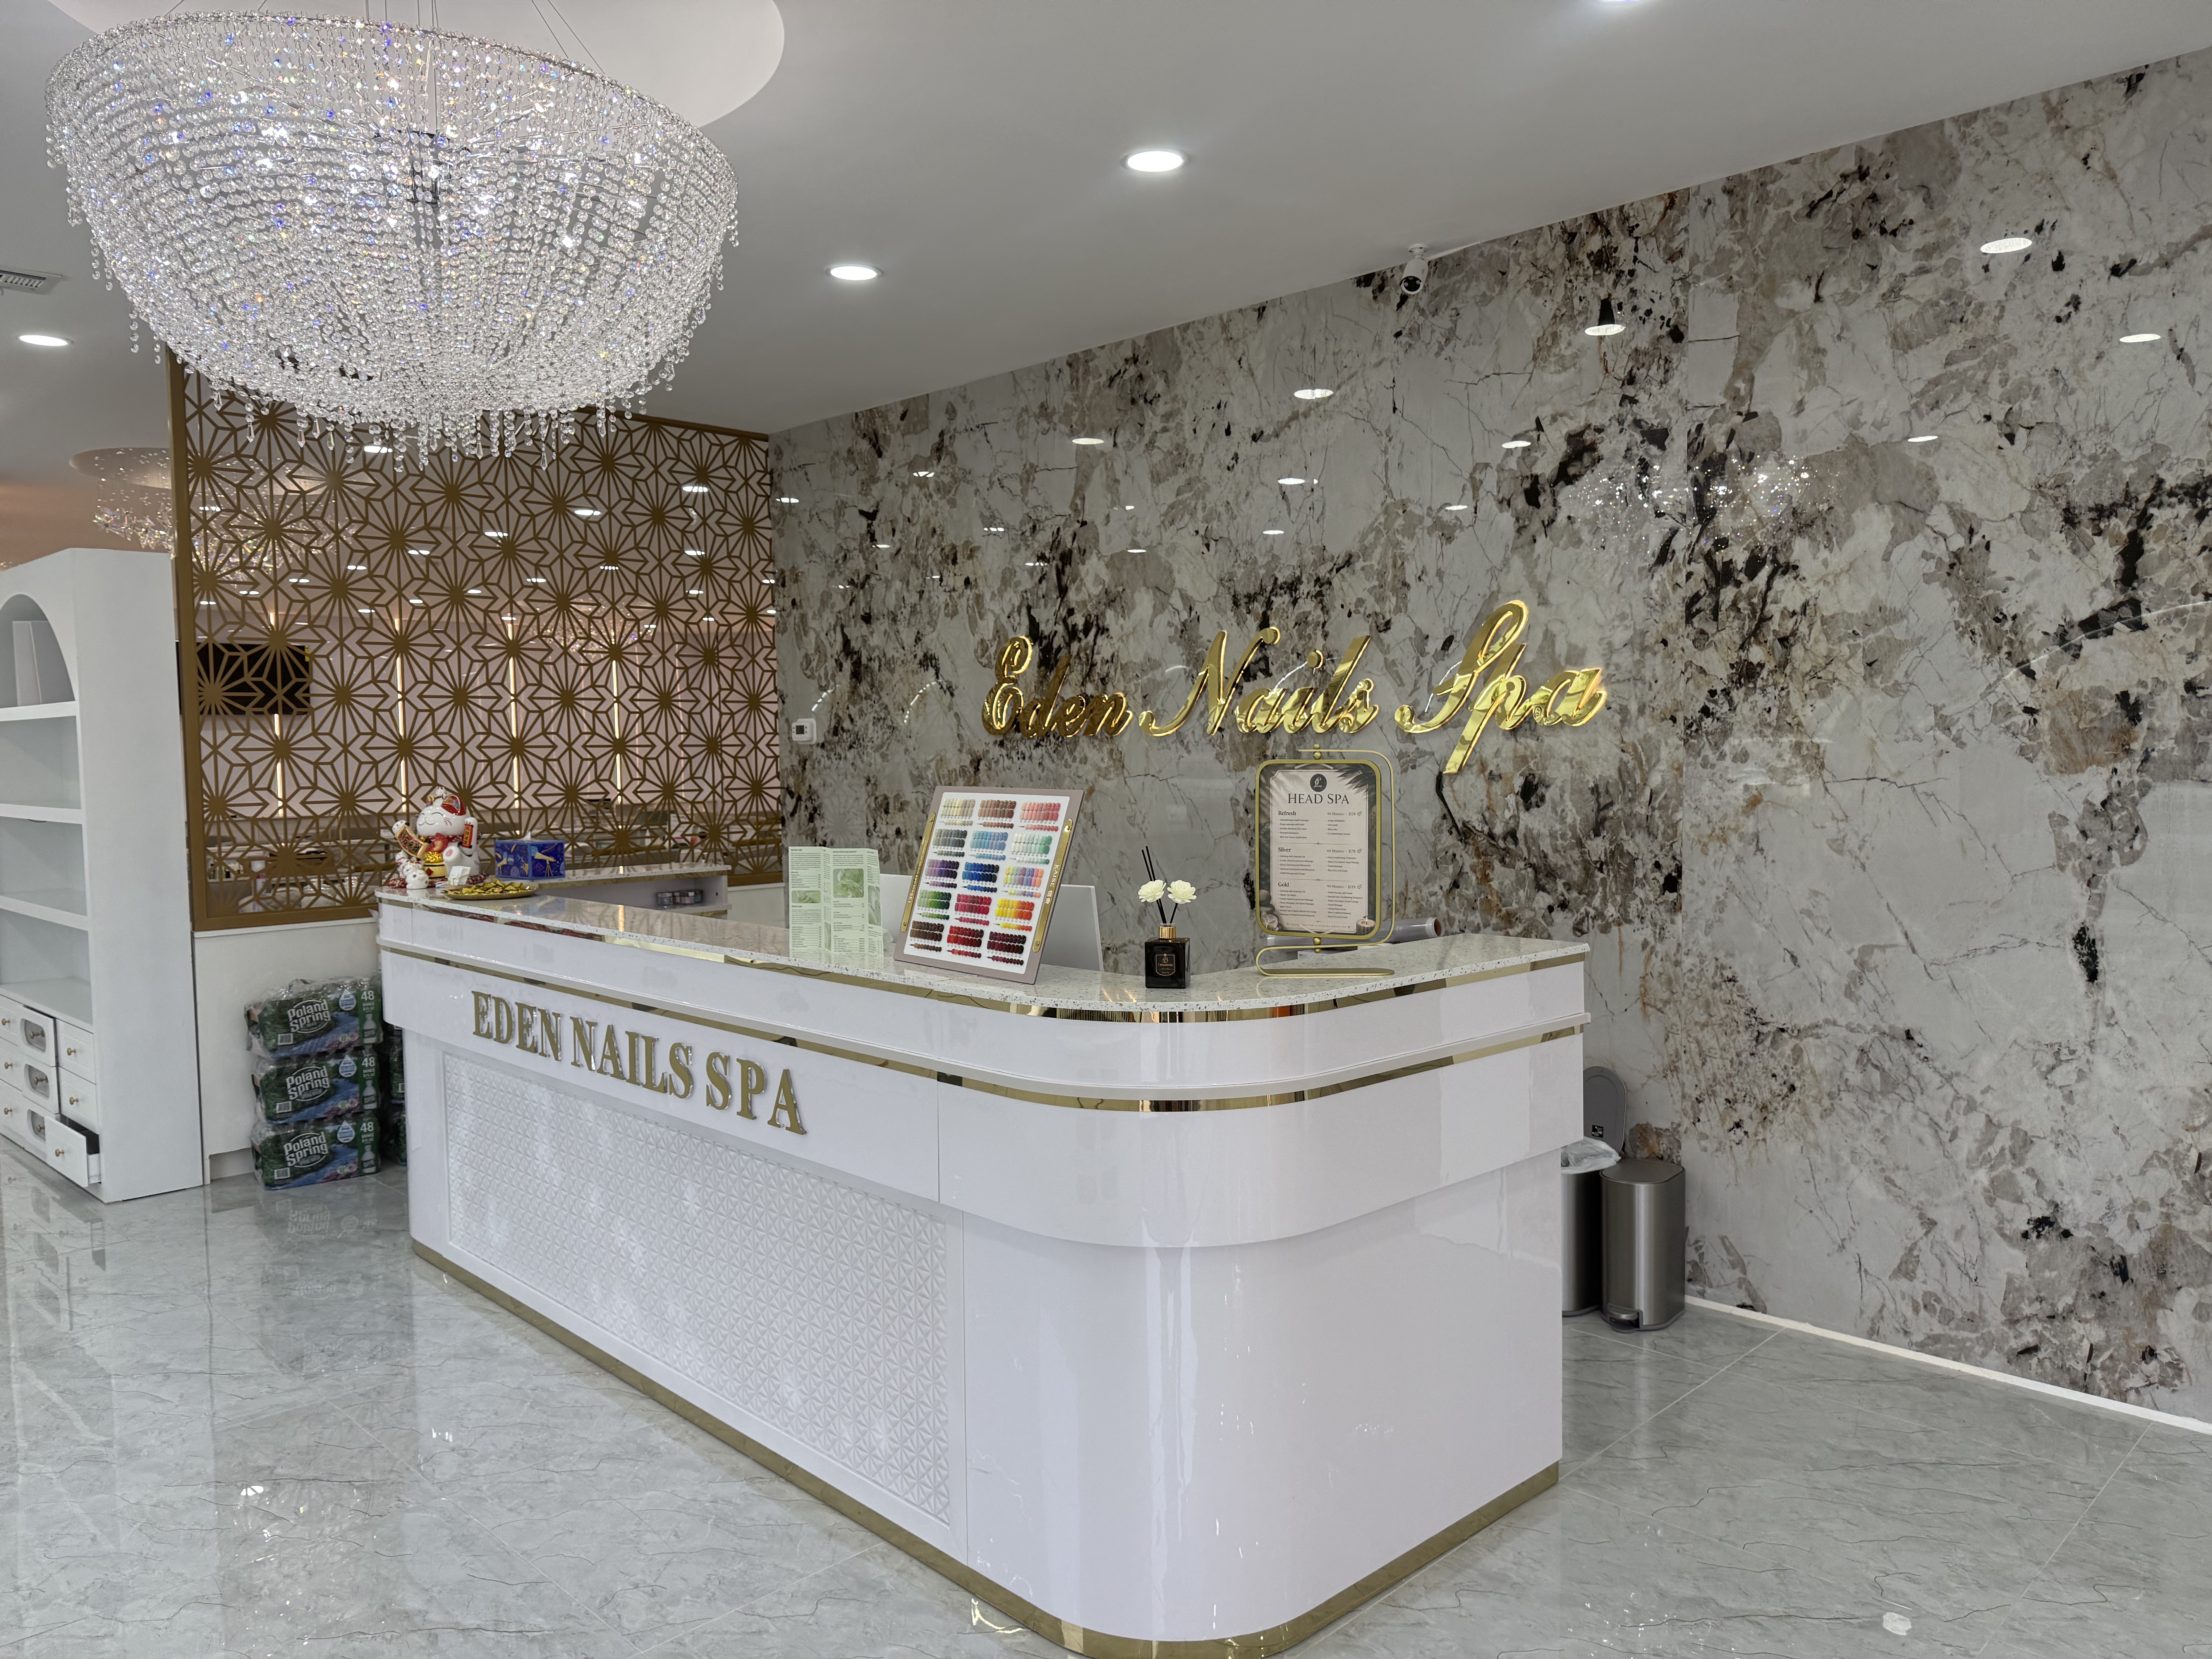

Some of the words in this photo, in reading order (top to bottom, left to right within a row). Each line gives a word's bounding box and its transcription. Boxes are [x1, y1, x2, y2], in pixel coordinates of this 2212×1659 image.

[982, 635, 1133, 738] Eden
[1138, 626, 1379, 736] Nails
[1395, 599, 1607, 775] Spa
[1288, 793, 1323, 804] HEAD
[1328, 793, 1350, 804] SPA
[1050, 864, 1060, 888] KAISE
[361, 990, 374, 1001] 48
[287, 999, 329, 1022] Poland
[289, 1011, 331, 1032] Spring
[361, 1057, 376, 1067] 48
[471, 990, 563, 1061] EDEN
[569, 1016, 693, 1099] NAILS
[705, 1051, 807, 1135] SPA
[285, 1065, 329, 1090] Poland
[287, 1077, 330, 1100] Spring
[360, 1121, 374, 1132] 48
[283, 1131, 326, 1156] Poland
[285, 1143, 329, 1166] Spring
